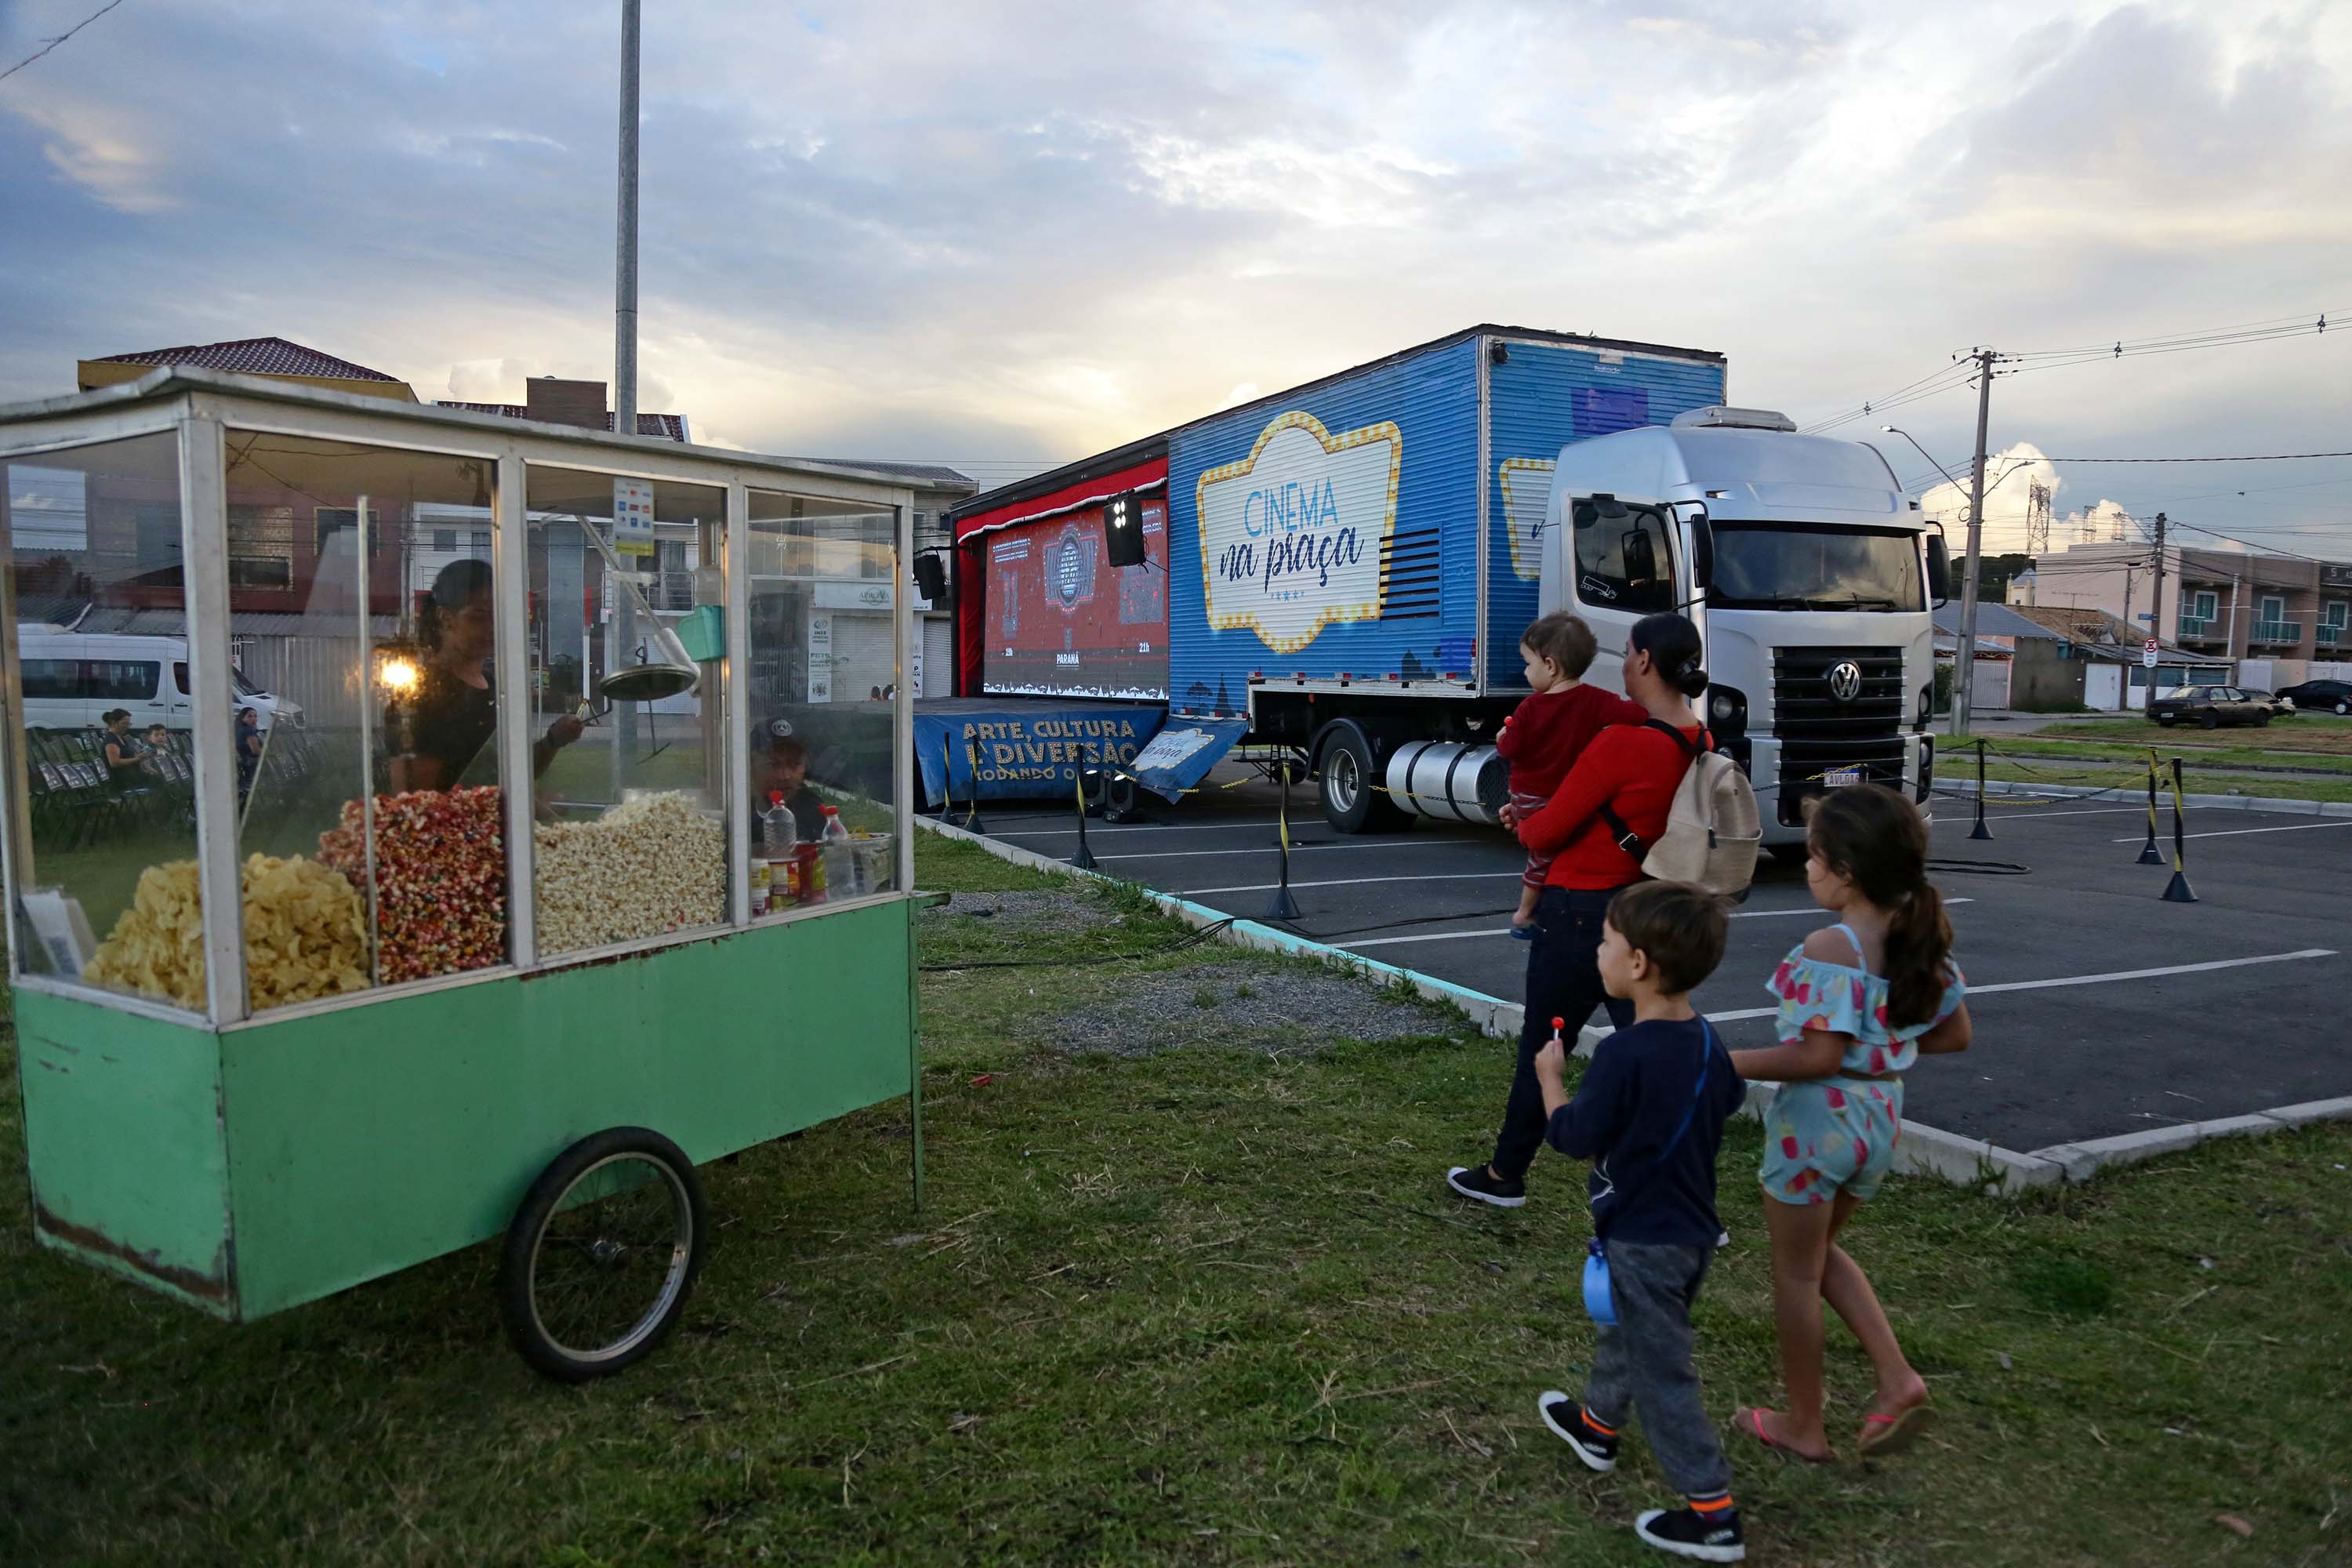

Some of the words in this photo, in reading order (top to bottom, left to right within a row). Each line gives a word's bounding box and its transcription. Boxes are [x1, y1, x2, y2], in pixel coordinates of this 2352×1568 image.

[1244, 477, 1338, 538] CINEMA
[1220, 543, 1260, 583] na
[1265, 526, 1365, 594] praça
[1056, 652, 1080, 665] PARANÁ
[1139, 642, 1150, 653] 21h
[964, 722, 1033, 742] ARTE,
[1033, 720, 1136, 738] CULTURA
